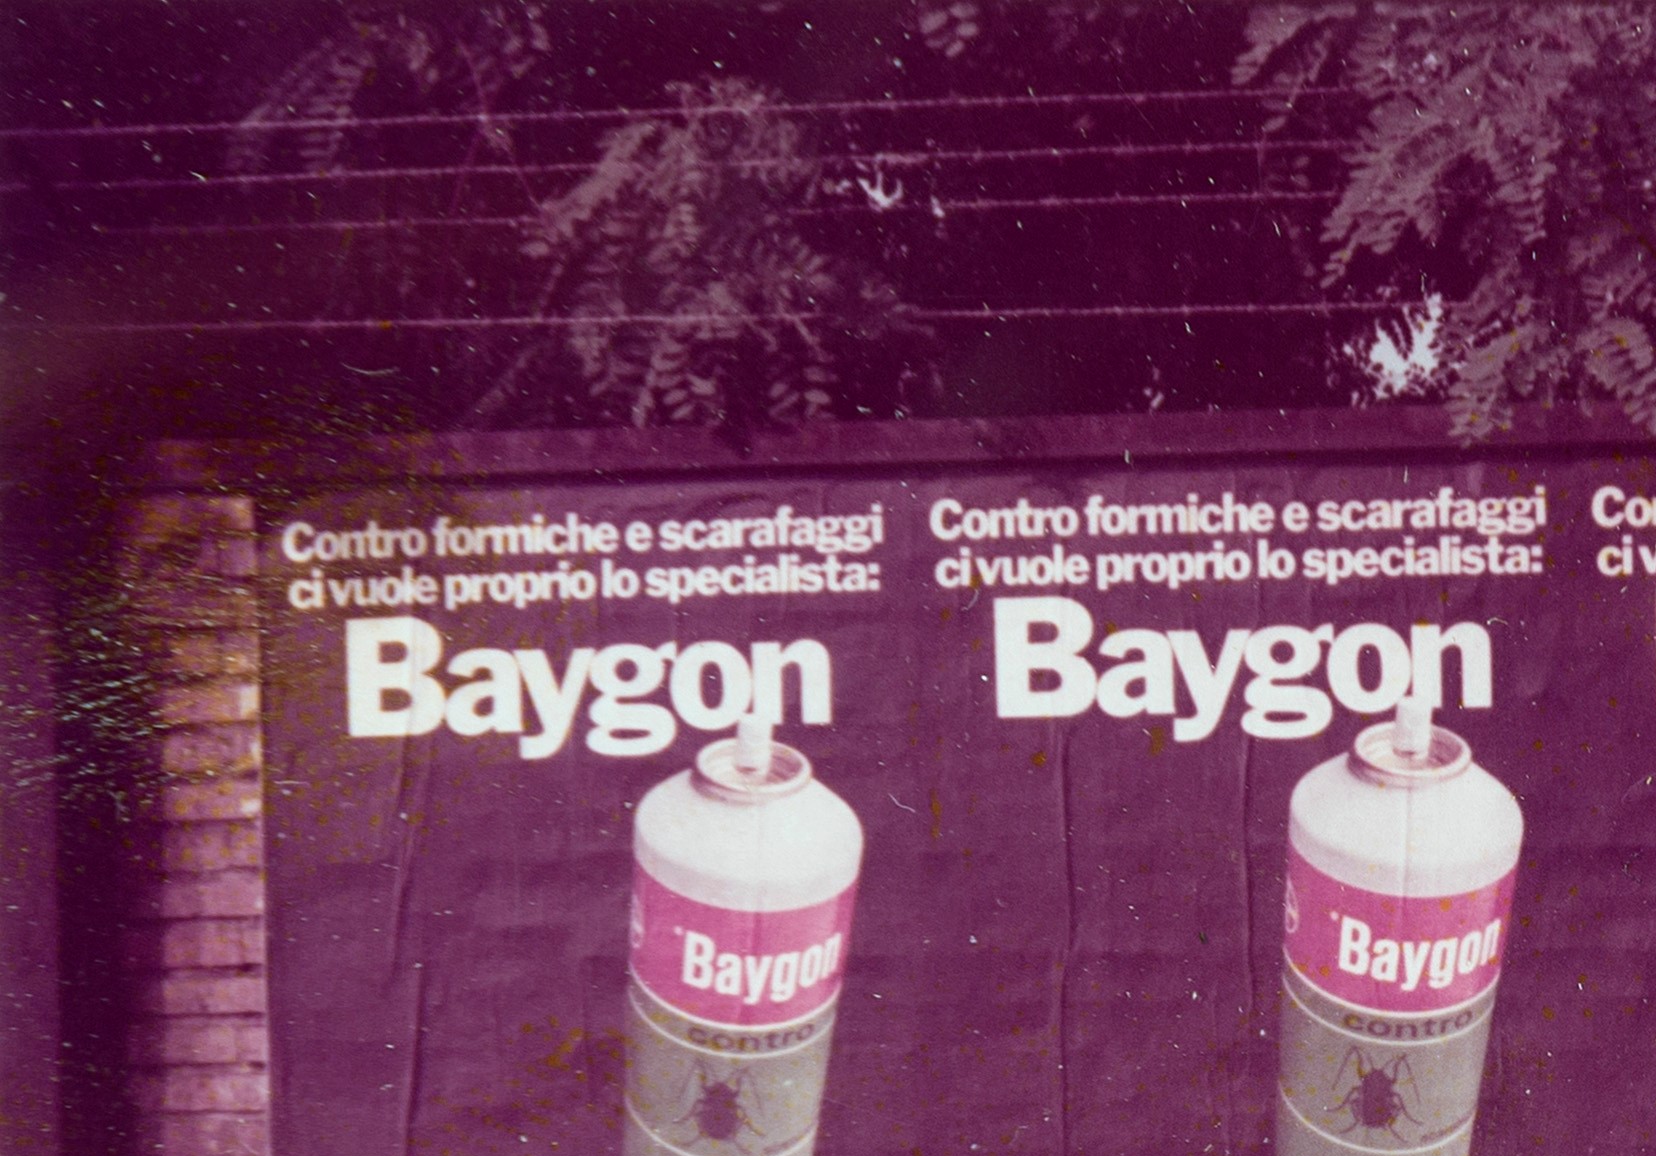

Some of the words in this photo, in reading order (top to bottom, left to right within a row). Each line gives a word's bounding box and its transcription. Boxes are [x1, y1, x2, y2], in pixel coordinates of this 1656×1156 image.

[282, 520, 427, 563] Contro
[433, 512, 619, 556] formiche
[625, 522, 654, 552] e
[658, 503, 884, 553] scarafaggi
[929, 498, 1079, 540] Contro
[1086, 494, 1275, 536] formiche
[1282, 502, 1309, 531] e
[1316, 487, 1547, 536] scarafaggi
[288, 569, 325, 609] ci
[329, 565, 439, 607] vuole
[444, 561, 598, 609] proprio
[602, 559, 640, 599] lo
[644, 554, 881, 604] specialista:
[934, 548, 971, 589] ci
[976, 544, 1090, 586] vuole
[1096, 540, 1252, 591] proprio
[1257, 540, 1296, 579] lo
[1301, 536, 1544, 585] specialista:
[1596, 534, 1633, 577] ci
[345, 615, 832, 760] Baygon
[994, 595, 1493, 742] Baygon
[682, 930, 842, 1005] Baygon
[1338, 915, 1501, 991] Baygon
[687, 1024, 814, 1051] contro
[1344, 1010, 1473, 1037] contro
